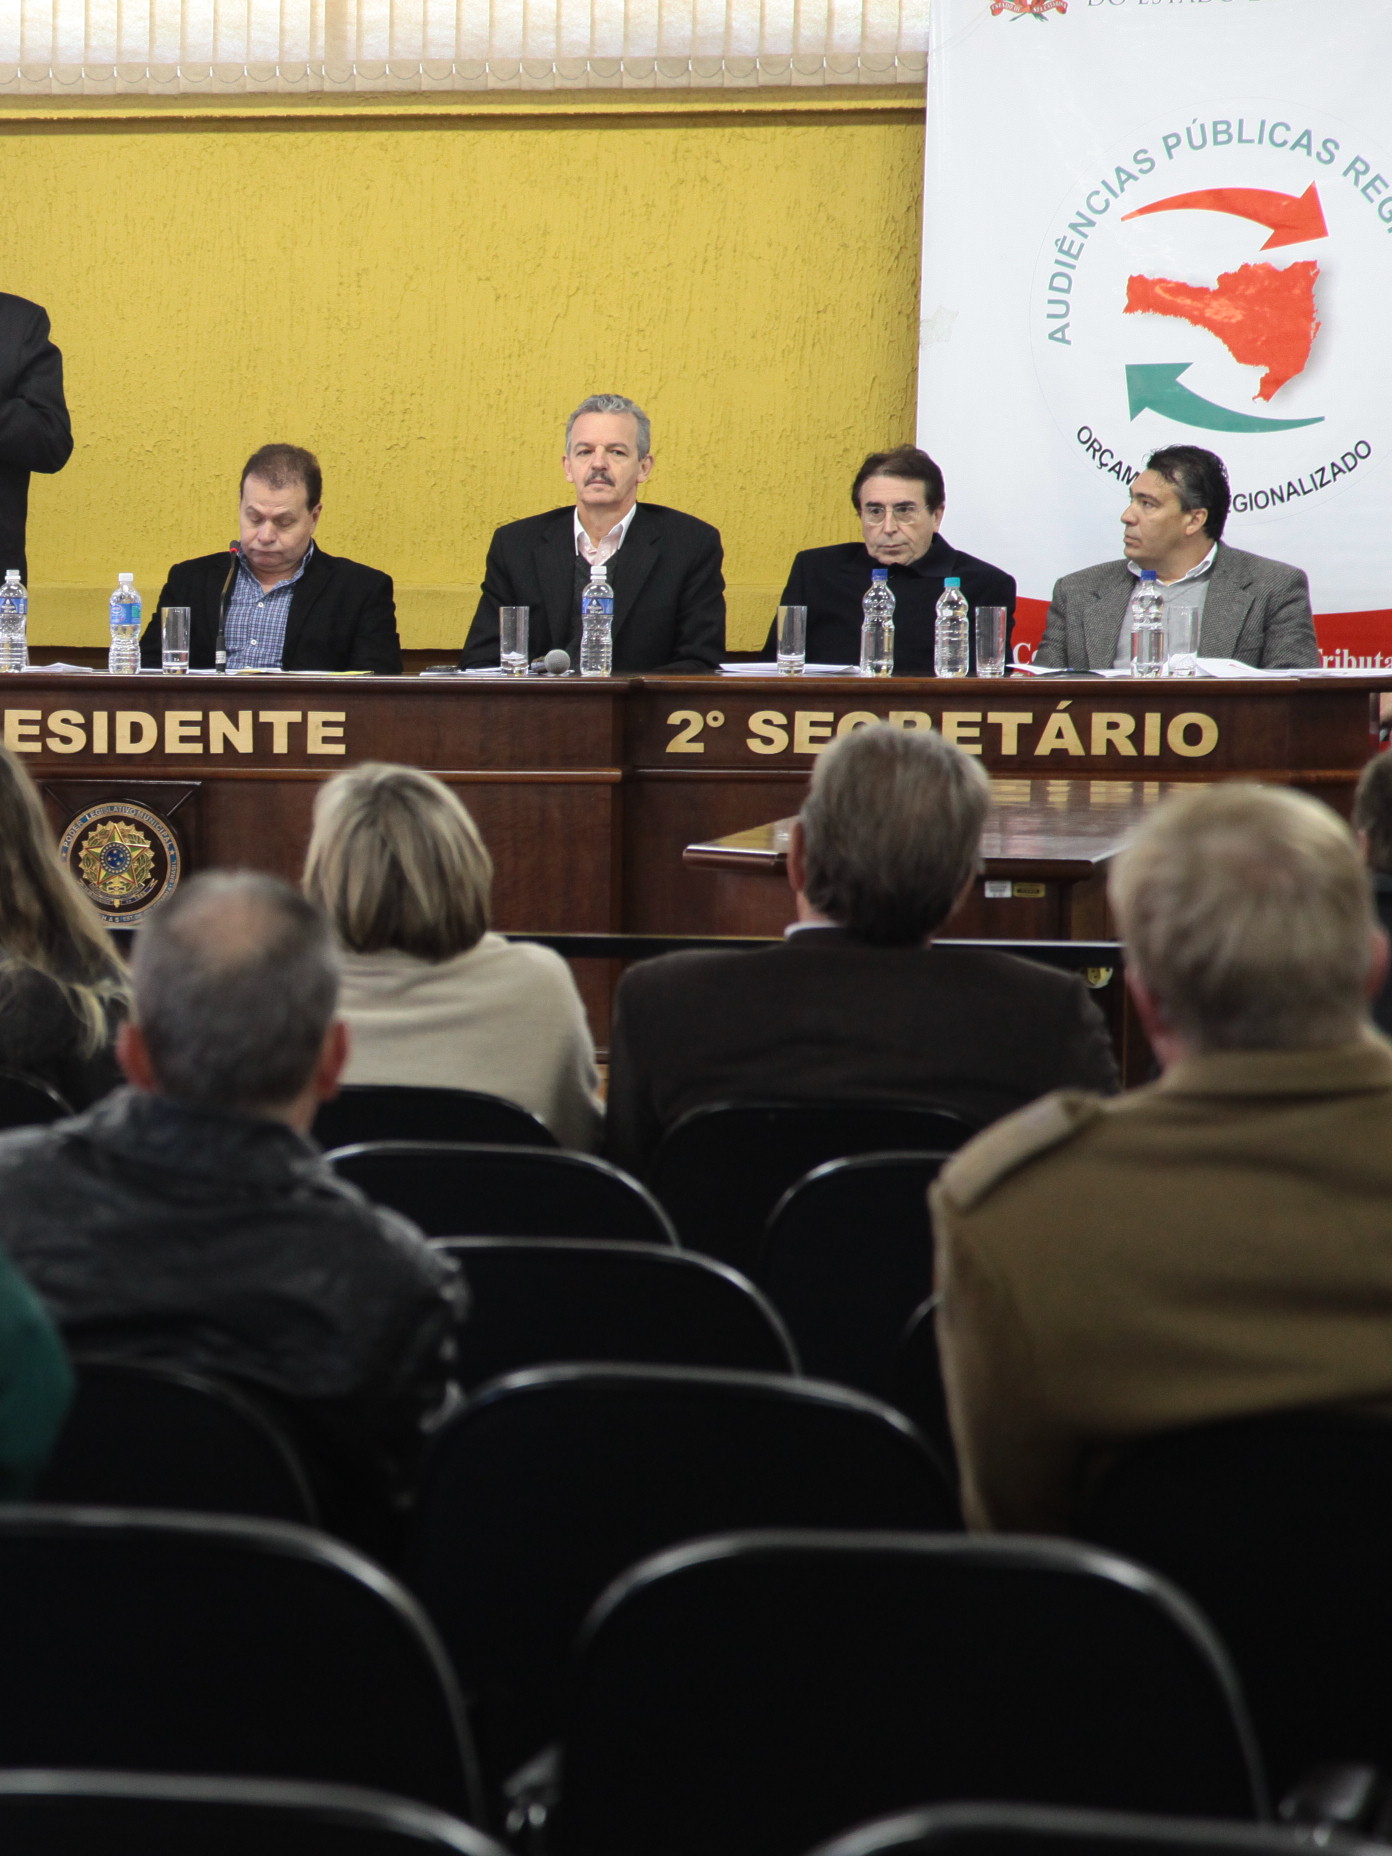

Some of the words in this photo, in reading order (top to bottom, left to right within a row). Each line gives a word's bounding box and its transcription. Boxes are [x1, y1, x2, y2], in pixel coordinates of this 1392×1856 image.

[1046, 147, 1157, 346] AUDIÊNCIAS
[1161, 118, 1341, 166] PÚBLICAS
[1342, 154, 1392, 234] REG
[1076, 425, 1141, 487] ORÇAM
[1226, 440, 1372, 513] GIONALIZADO
[136, 810, 174, 846] MUNICIPAL
